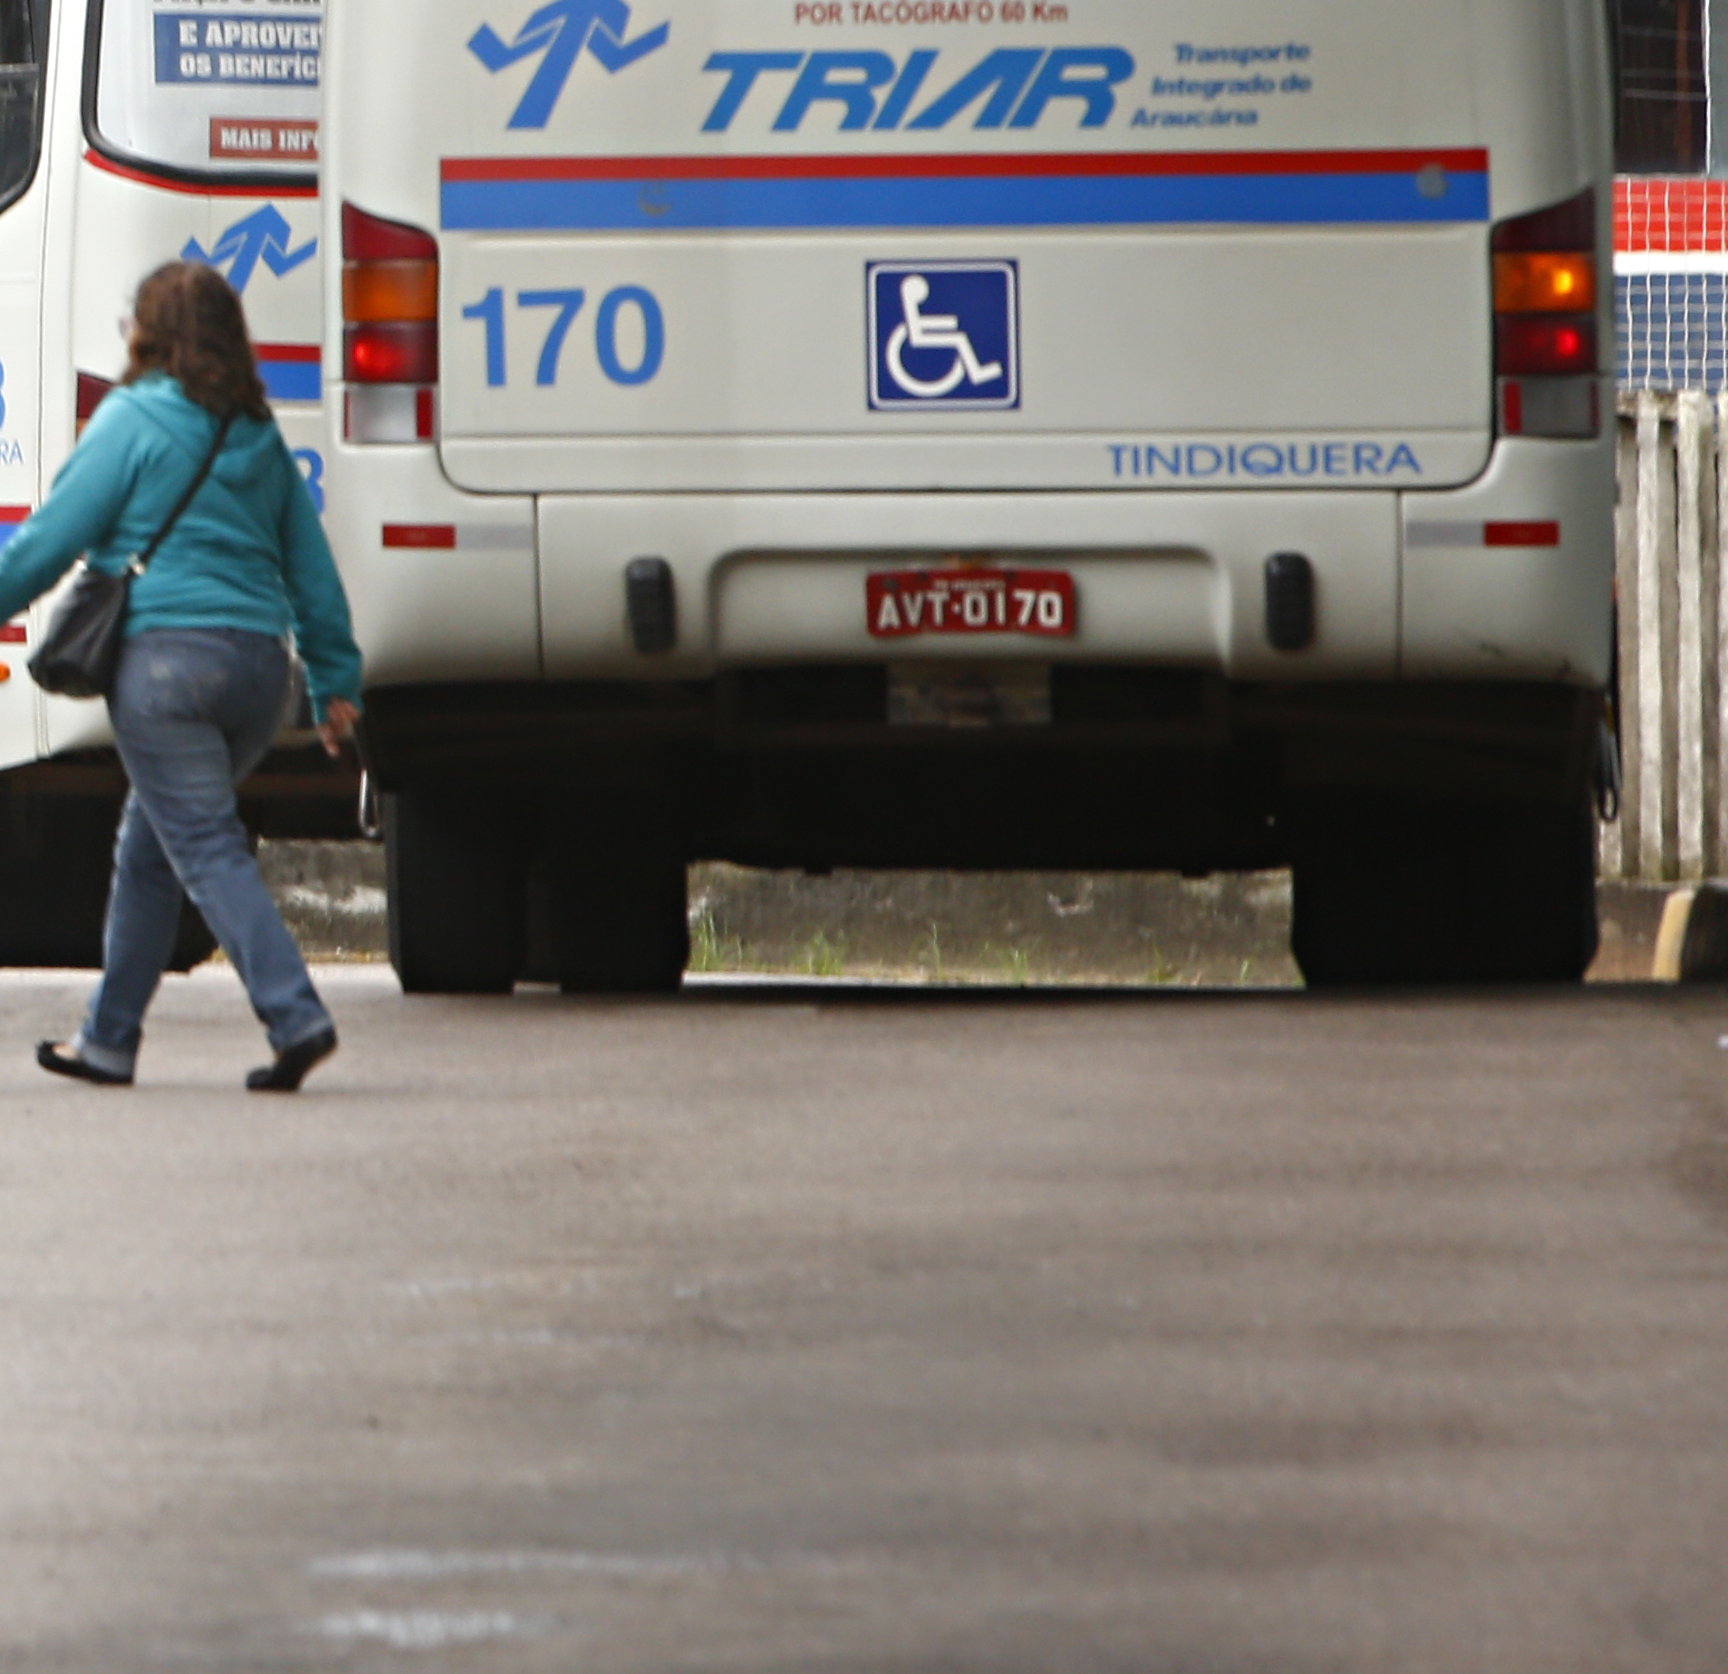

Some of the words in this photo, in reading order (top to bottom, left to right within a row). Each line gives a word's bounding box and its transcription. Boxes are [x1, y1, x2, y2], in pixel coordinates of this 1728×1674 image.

[795, 1, 846, 26] POR
[1001, 0, 1027, 24] 60
[1033, 0, 1069, 24] Km
[179, 20, 198, 48] E
[205, 21, 323, 49] APROVEI
[179, 52, 212, 78] OS
[1173, 42, 1311, 68] Transporte
[700, 46, 1136, 132] TRIAR
[1150, 73, 1277, 98] Integrado
[1283, 73, 1312, 94] de
[220, 126, 272, 150] MAIS
[461, 283, 665, 388] 170
[1107, 441, 1422, 477] TINDIQUERA
